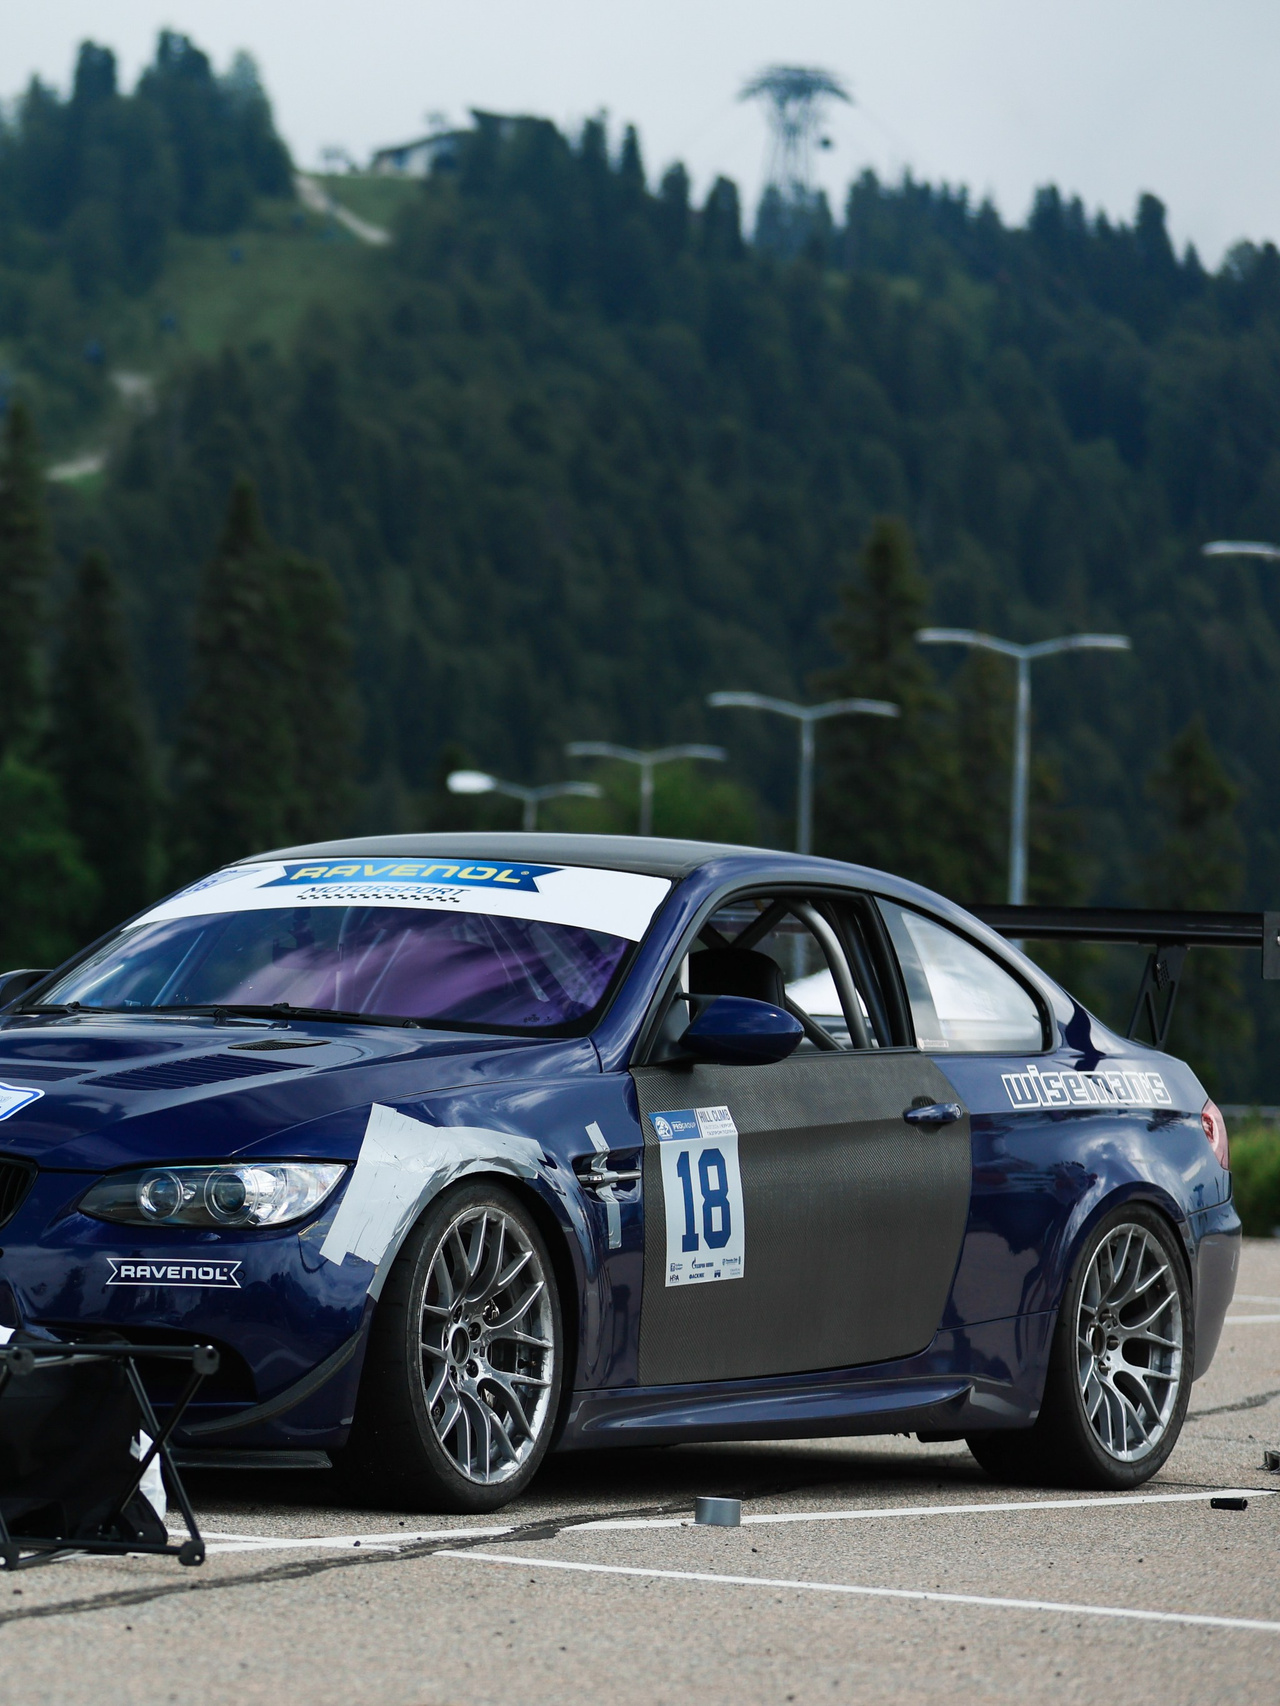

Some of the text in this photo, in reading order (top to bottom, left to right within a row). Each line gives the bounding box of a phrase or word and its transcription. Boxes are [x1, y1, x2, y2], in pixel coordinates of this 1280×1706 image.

[289, 864, 522, 884] RAVENOL
[303, 884, 471, 897] MOTORSPORT
[676, 1148, 732, 1252] 18
[120, 1265, 228, 1281] RAVENOL
